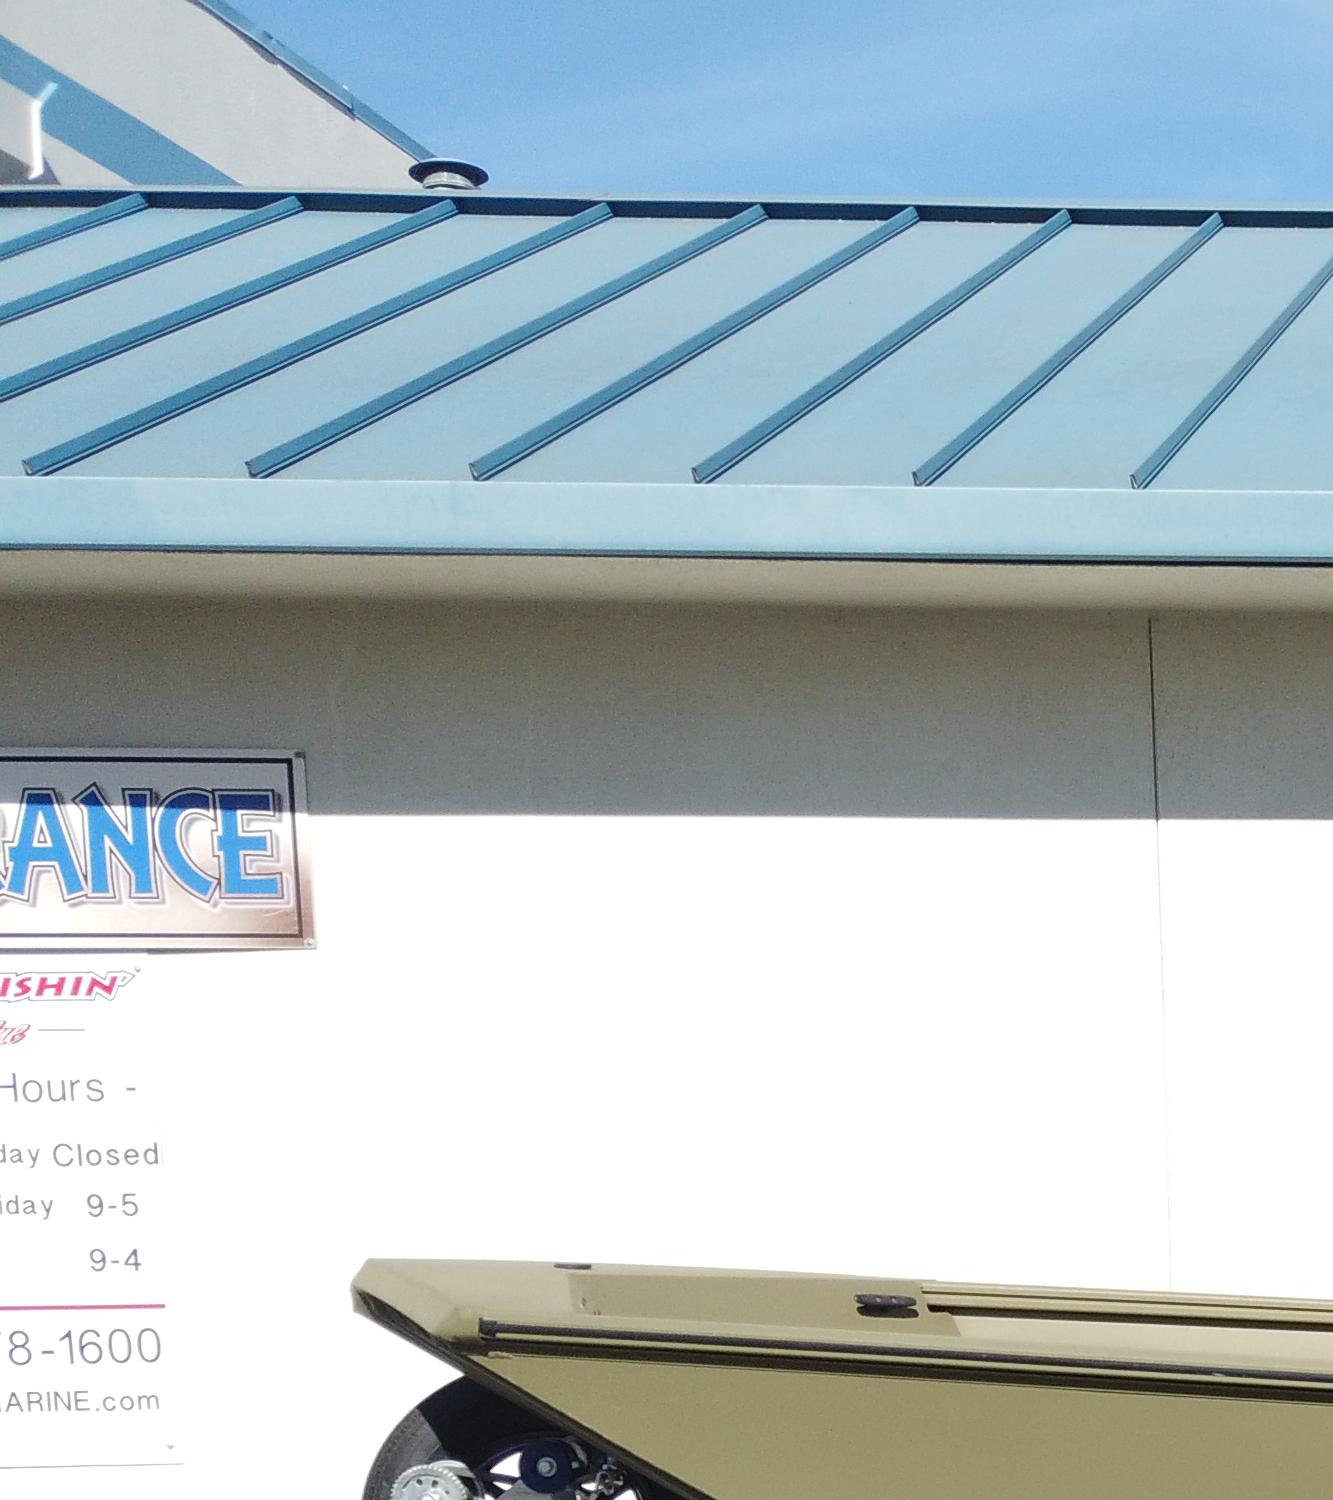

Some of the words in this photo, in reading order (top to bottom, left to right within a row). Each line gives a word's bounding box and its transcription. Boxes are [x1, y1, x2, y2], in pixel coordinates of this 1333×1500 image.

[0, 782, 285, 902] ANCE
[52, 1142, 159, 1167] Closed
[86, 1193, 139, 1218] 9-5
[89, 1248, 142, 1272] 9-4
[0, 1327, 162, 1366] 8-1600
[0, 1390, 160, 1413] ARINE.com
